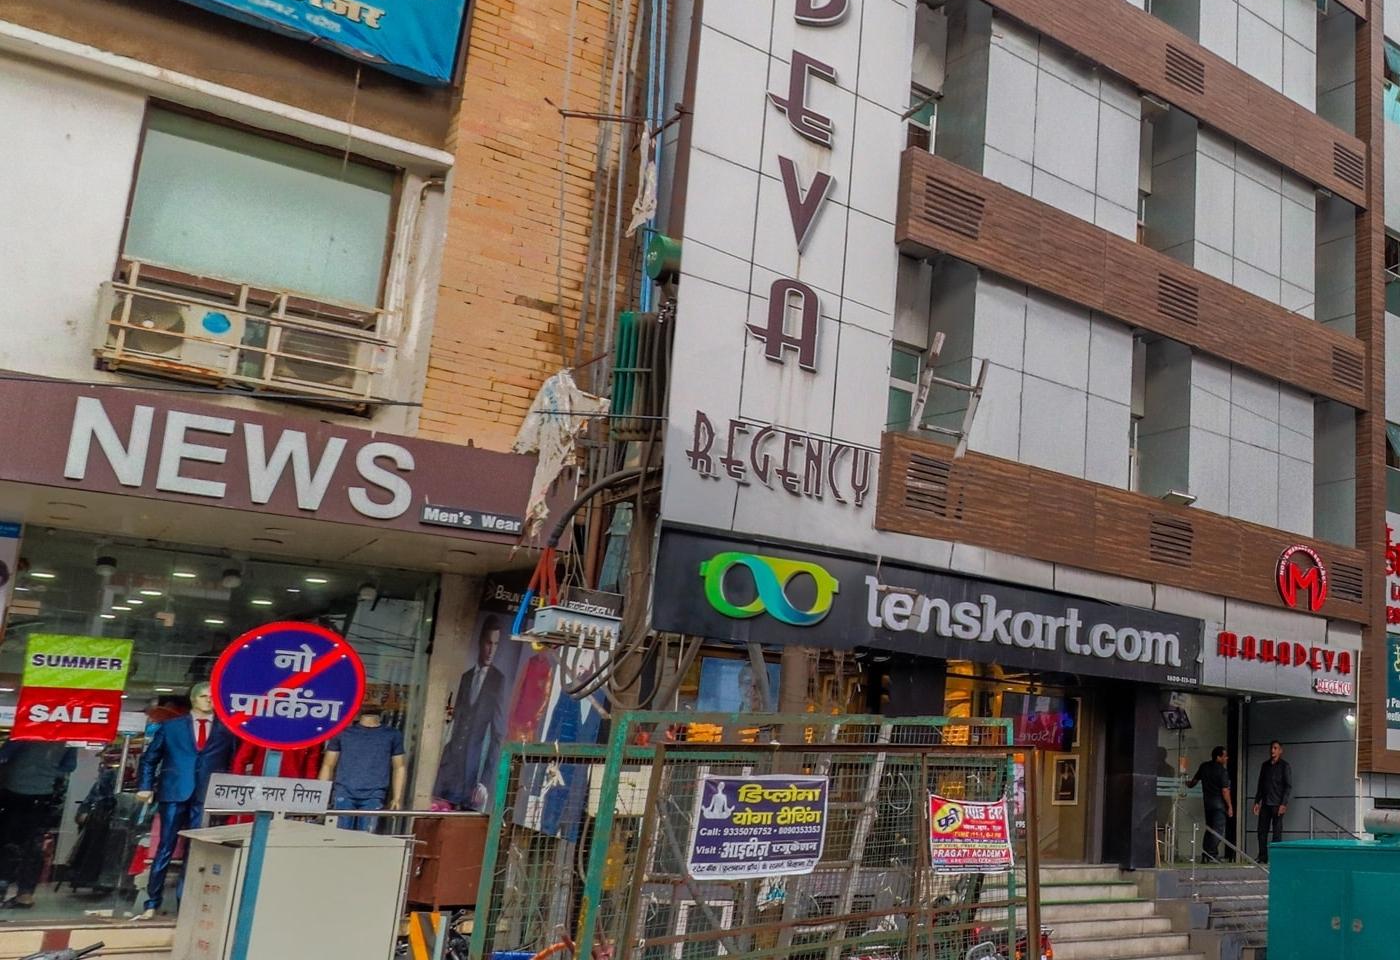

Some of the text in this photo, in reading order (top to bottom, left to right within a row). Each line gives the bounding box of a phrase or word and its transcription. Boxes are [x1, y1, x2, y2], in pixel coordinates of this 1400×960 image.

[64, 396, 415, 519] NEWS
[686, 410, 871, 506] REGENCY
[424, 505, 521, 533] Men's Wear
[865, 575, 1181, 667] lenskart.com
[32, 653, 123, 672] SUMMER
[274, 643, 317, 672] नो
[1217, 631, 1351, 675] MAHADEVA
[29, 703, 110, 724] SALE
[229, 686, 345, 722] पार्किंग
[214, 783, 323, 806] कानपुर नगर निगम
[737, 783, 821, 803] डिप्लोमा
[732, 807, 774, 825] योगा
[699, 827, 721, 836] Call:
[933, 849, 1007, 858] PRAGATI ACADEMY
